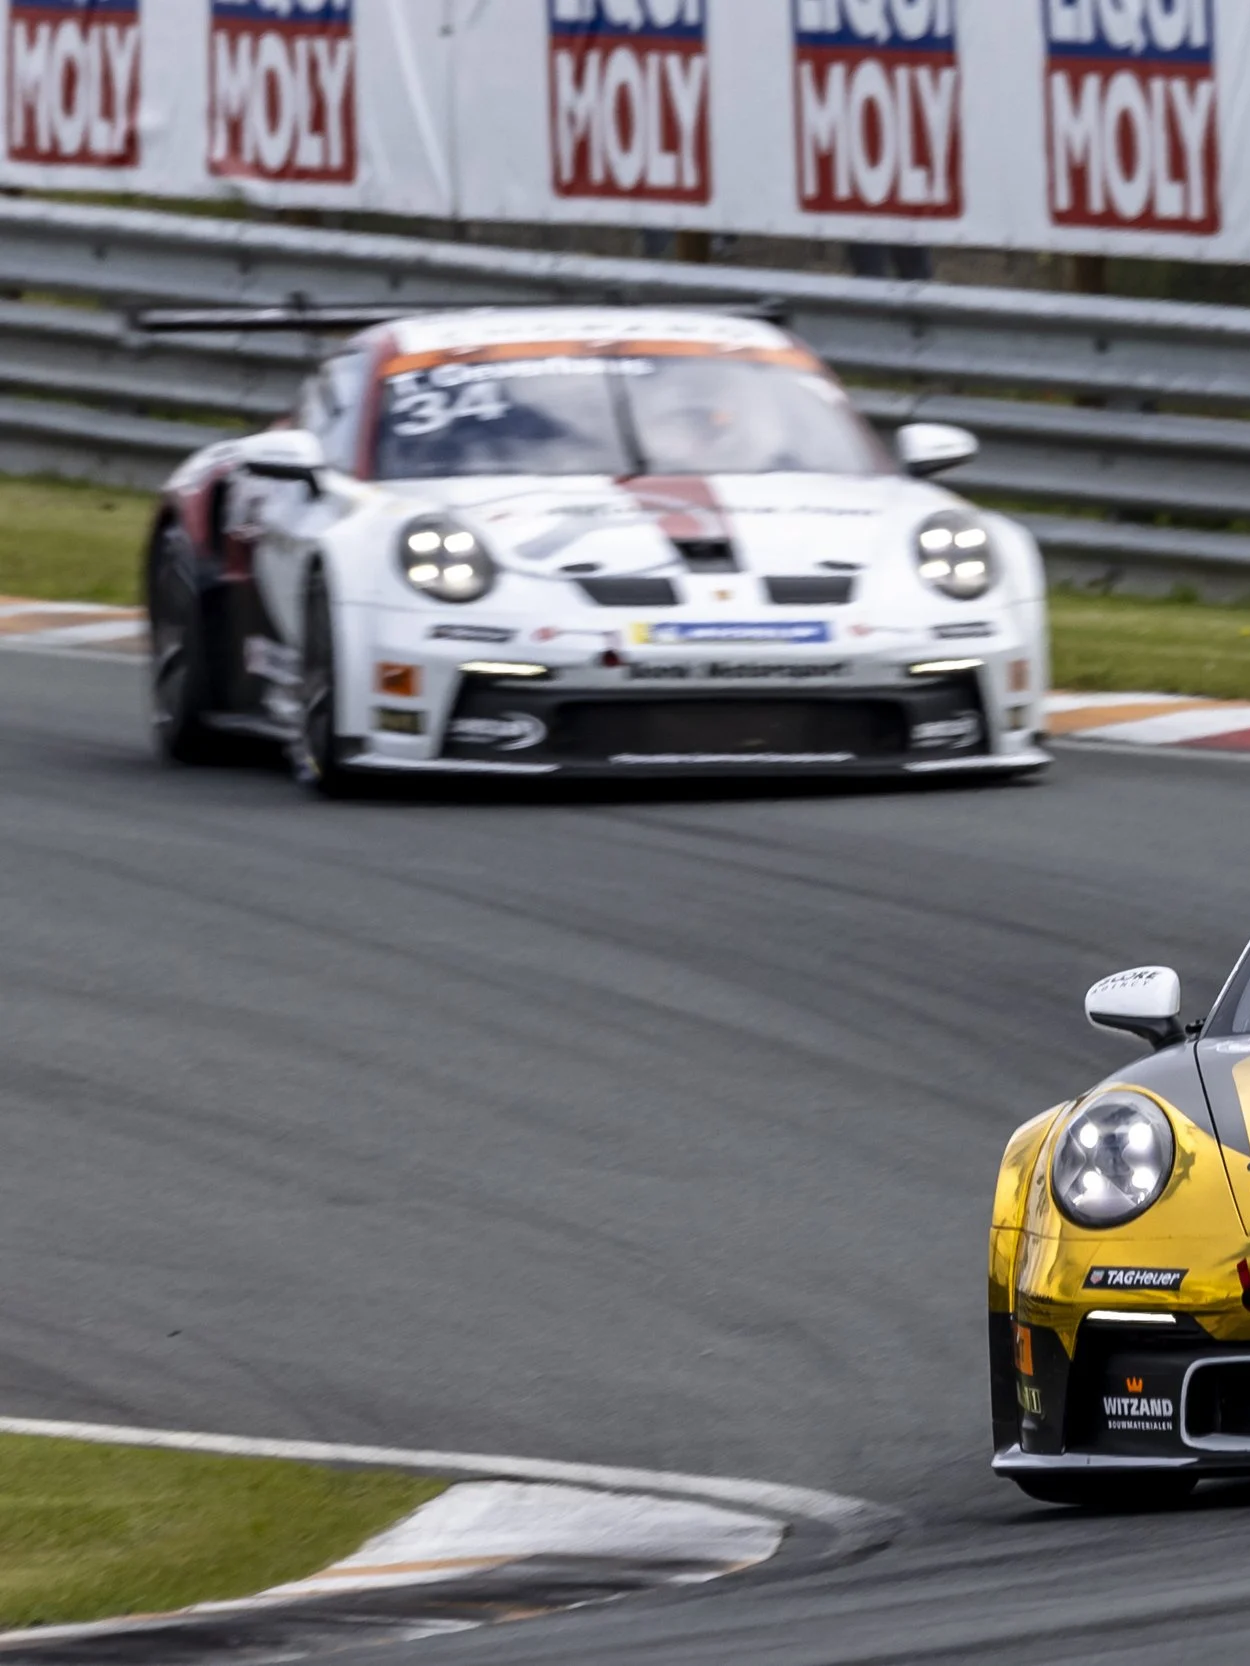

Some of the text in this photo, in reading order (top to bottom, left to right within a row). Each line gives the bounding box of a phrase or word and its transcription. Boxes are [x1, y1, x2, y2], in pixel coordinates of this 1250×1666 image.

[10, 20, 139, 156] MOLY
[211, 31, 352, 170] MOLY
[554, 47, 706, 188] MOLY
[800, 59, 957, 204] MOLY
[1050, 71, 1214, 219] MOLY
[392, 382, 508, 436] 34
[1103, 1397, 1173, 1416] WITZAND
[1108, 1420, 1173, 1431] BOUWMATERIALEN
